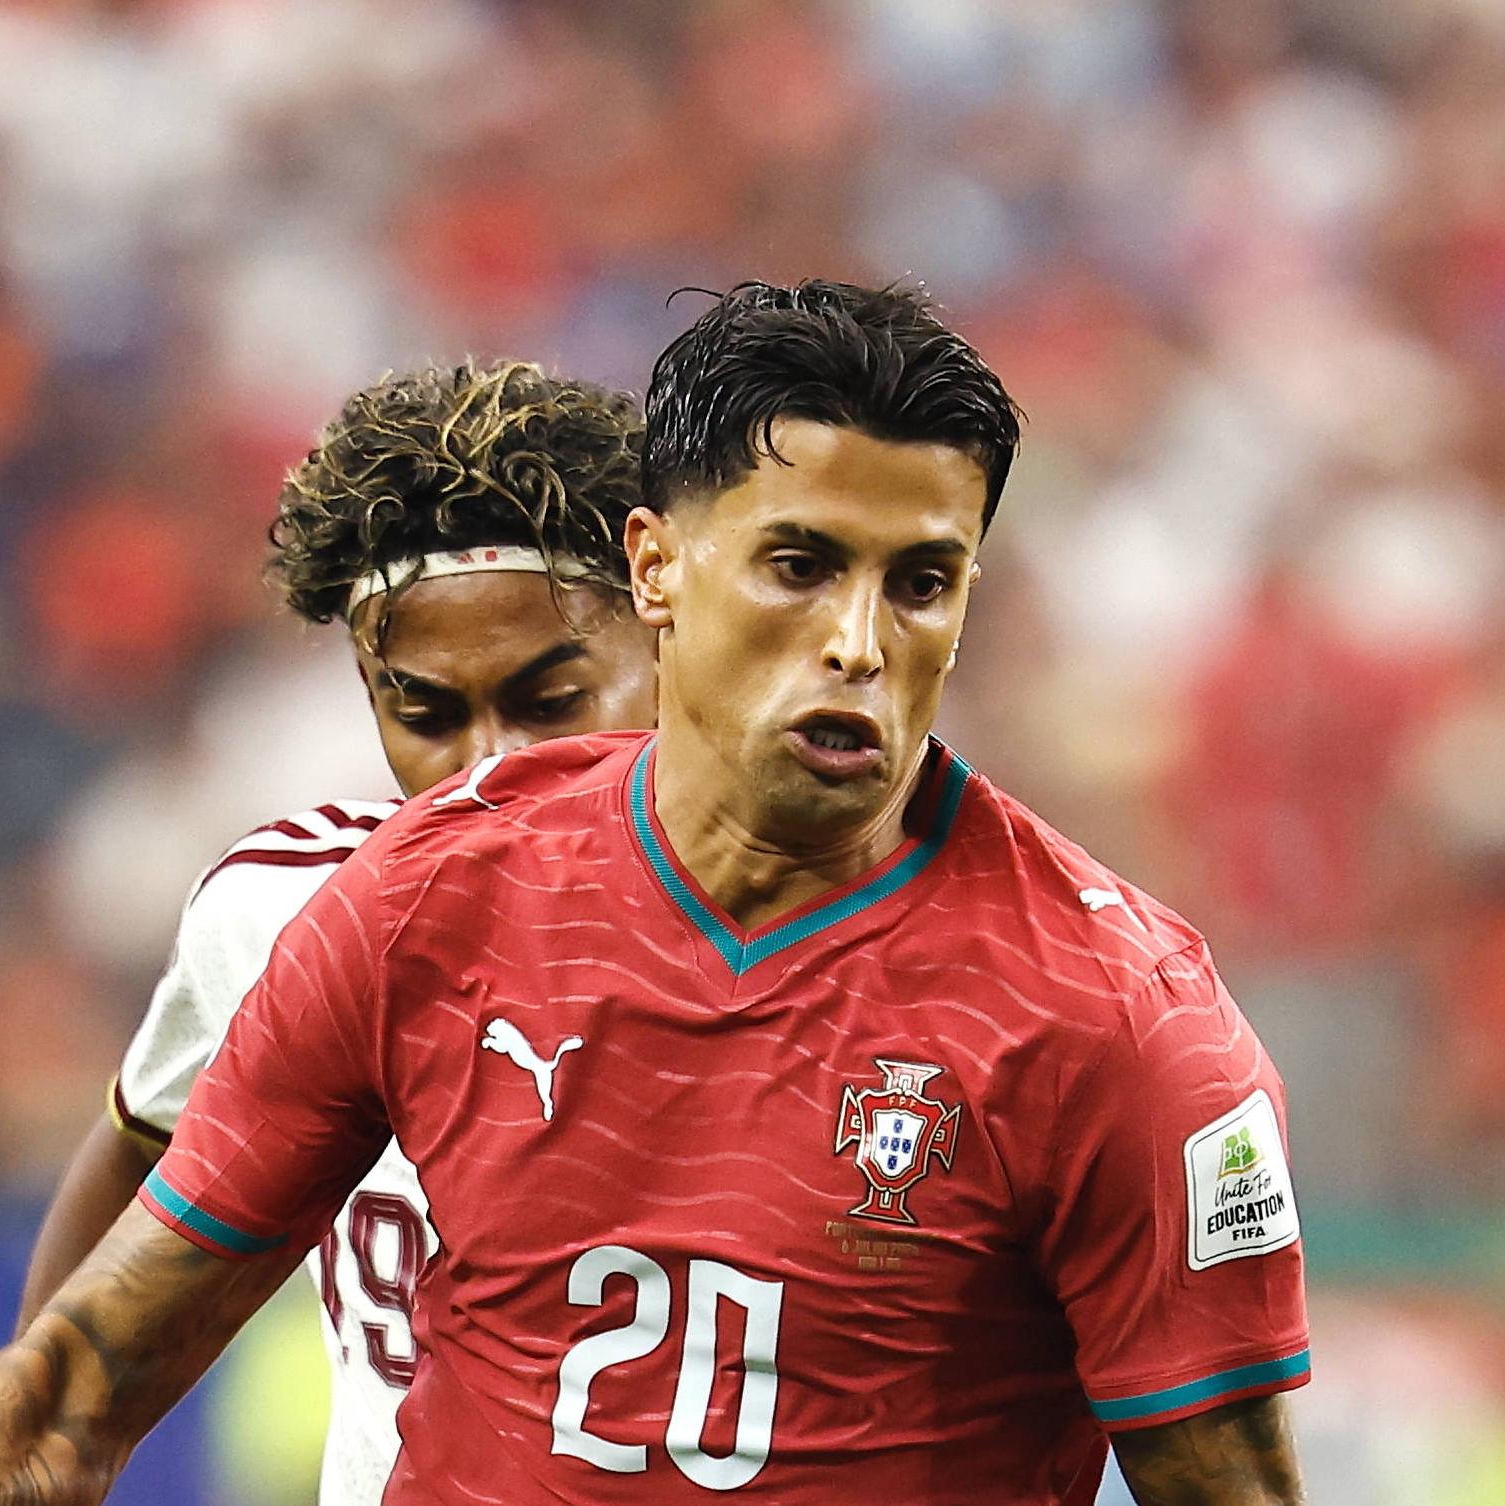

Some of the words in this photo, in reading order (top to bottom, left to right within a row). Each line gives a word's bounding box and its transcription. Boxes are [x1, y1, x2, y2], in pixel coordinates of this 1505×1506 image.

[1214, 1177, 1253, 1207] Unite
[1207, 1190, 1285, 1235] EDUCATION
[1232, 1226, 1266, 1241] FIFA
[551, 1245, 784, 1490] 20
